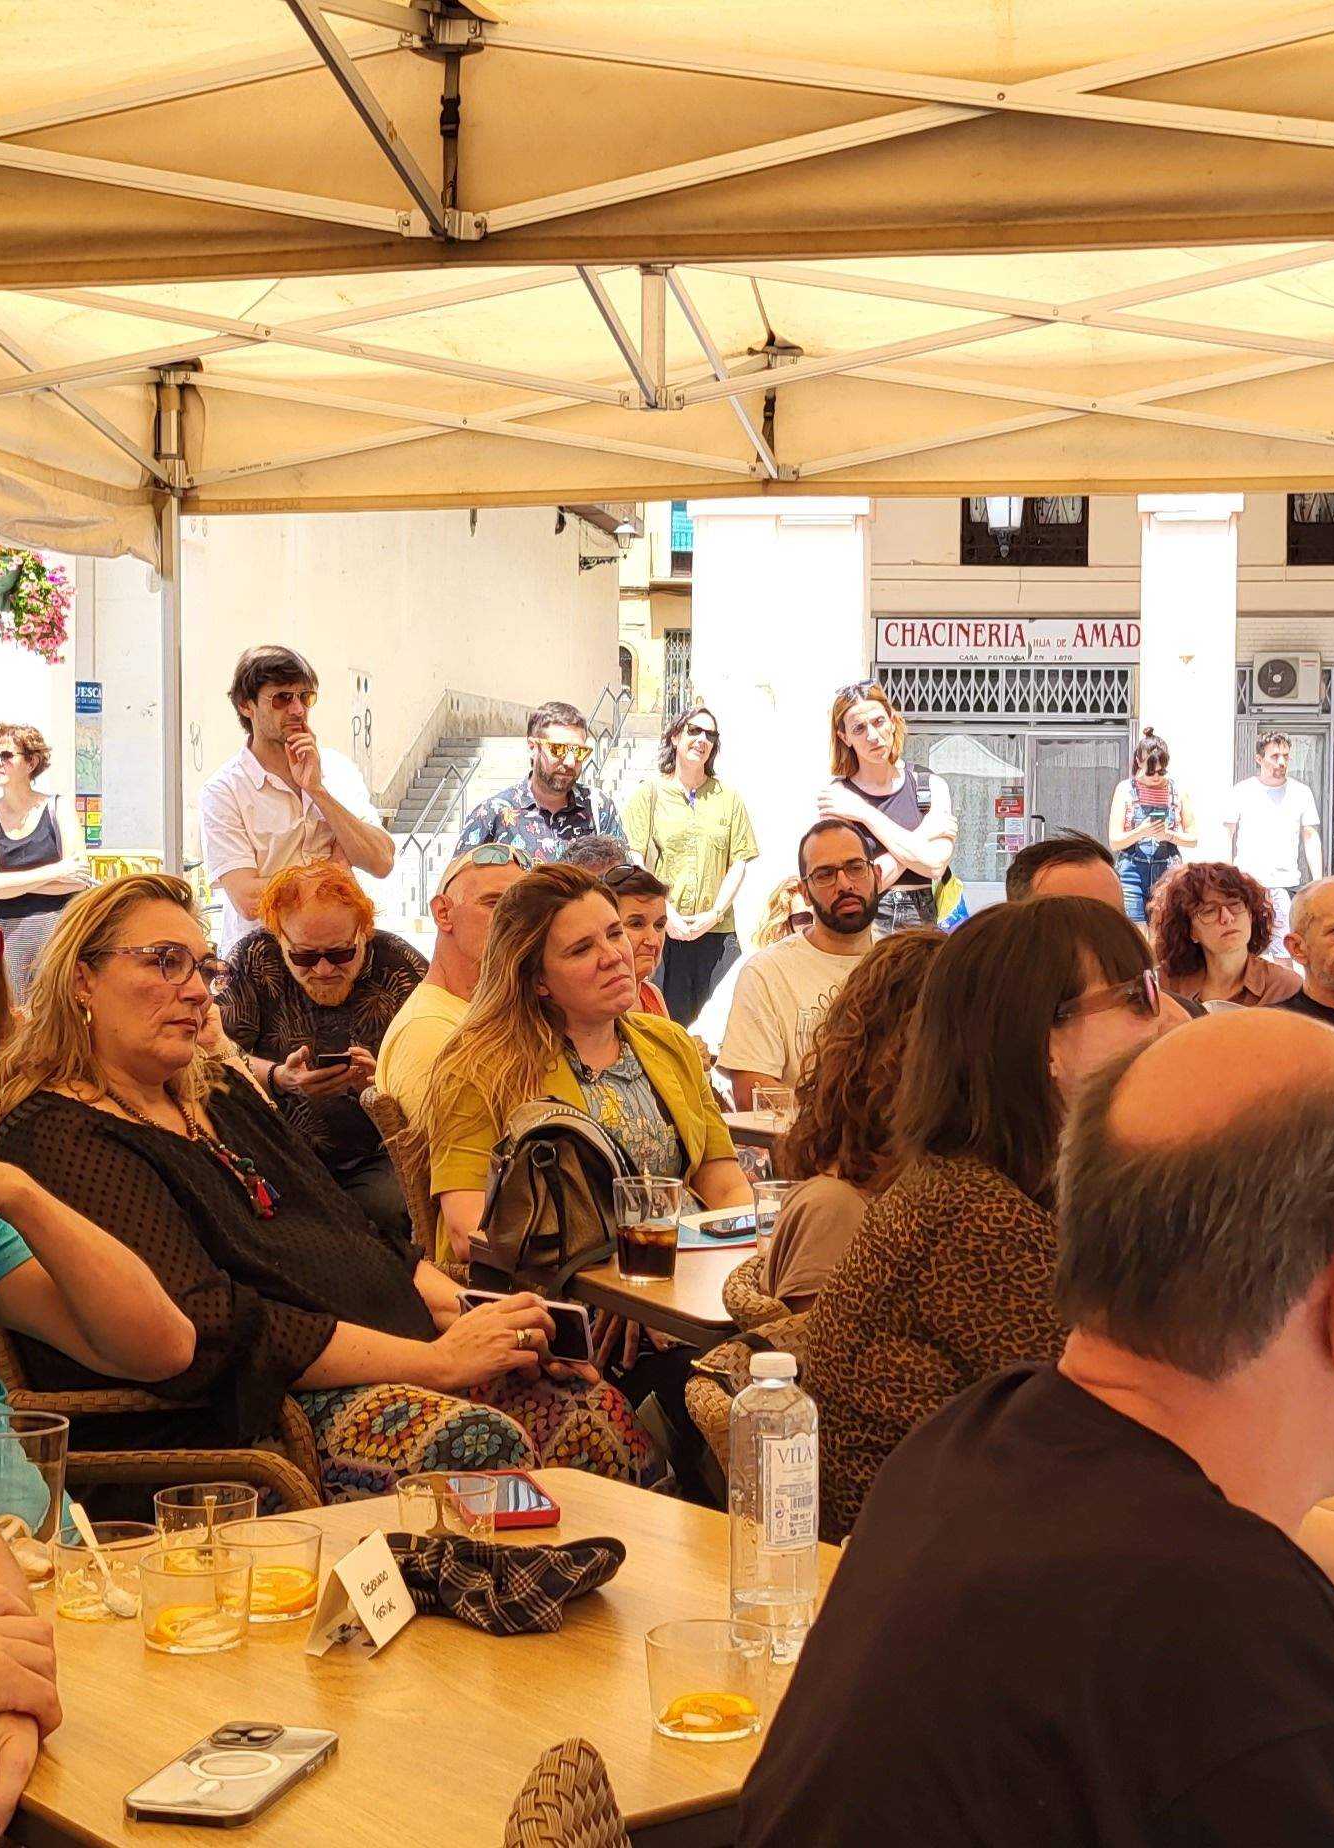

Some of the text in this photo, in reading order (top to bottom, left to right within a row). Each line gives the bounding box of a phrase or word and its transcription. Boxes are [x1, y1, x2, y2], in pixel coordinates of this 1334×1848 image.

[884, 622, 1026, 648] CHACINERIA
[1072, 622, 1141, 648] AMAD
[777, 1445, 814, 1465] VILA
